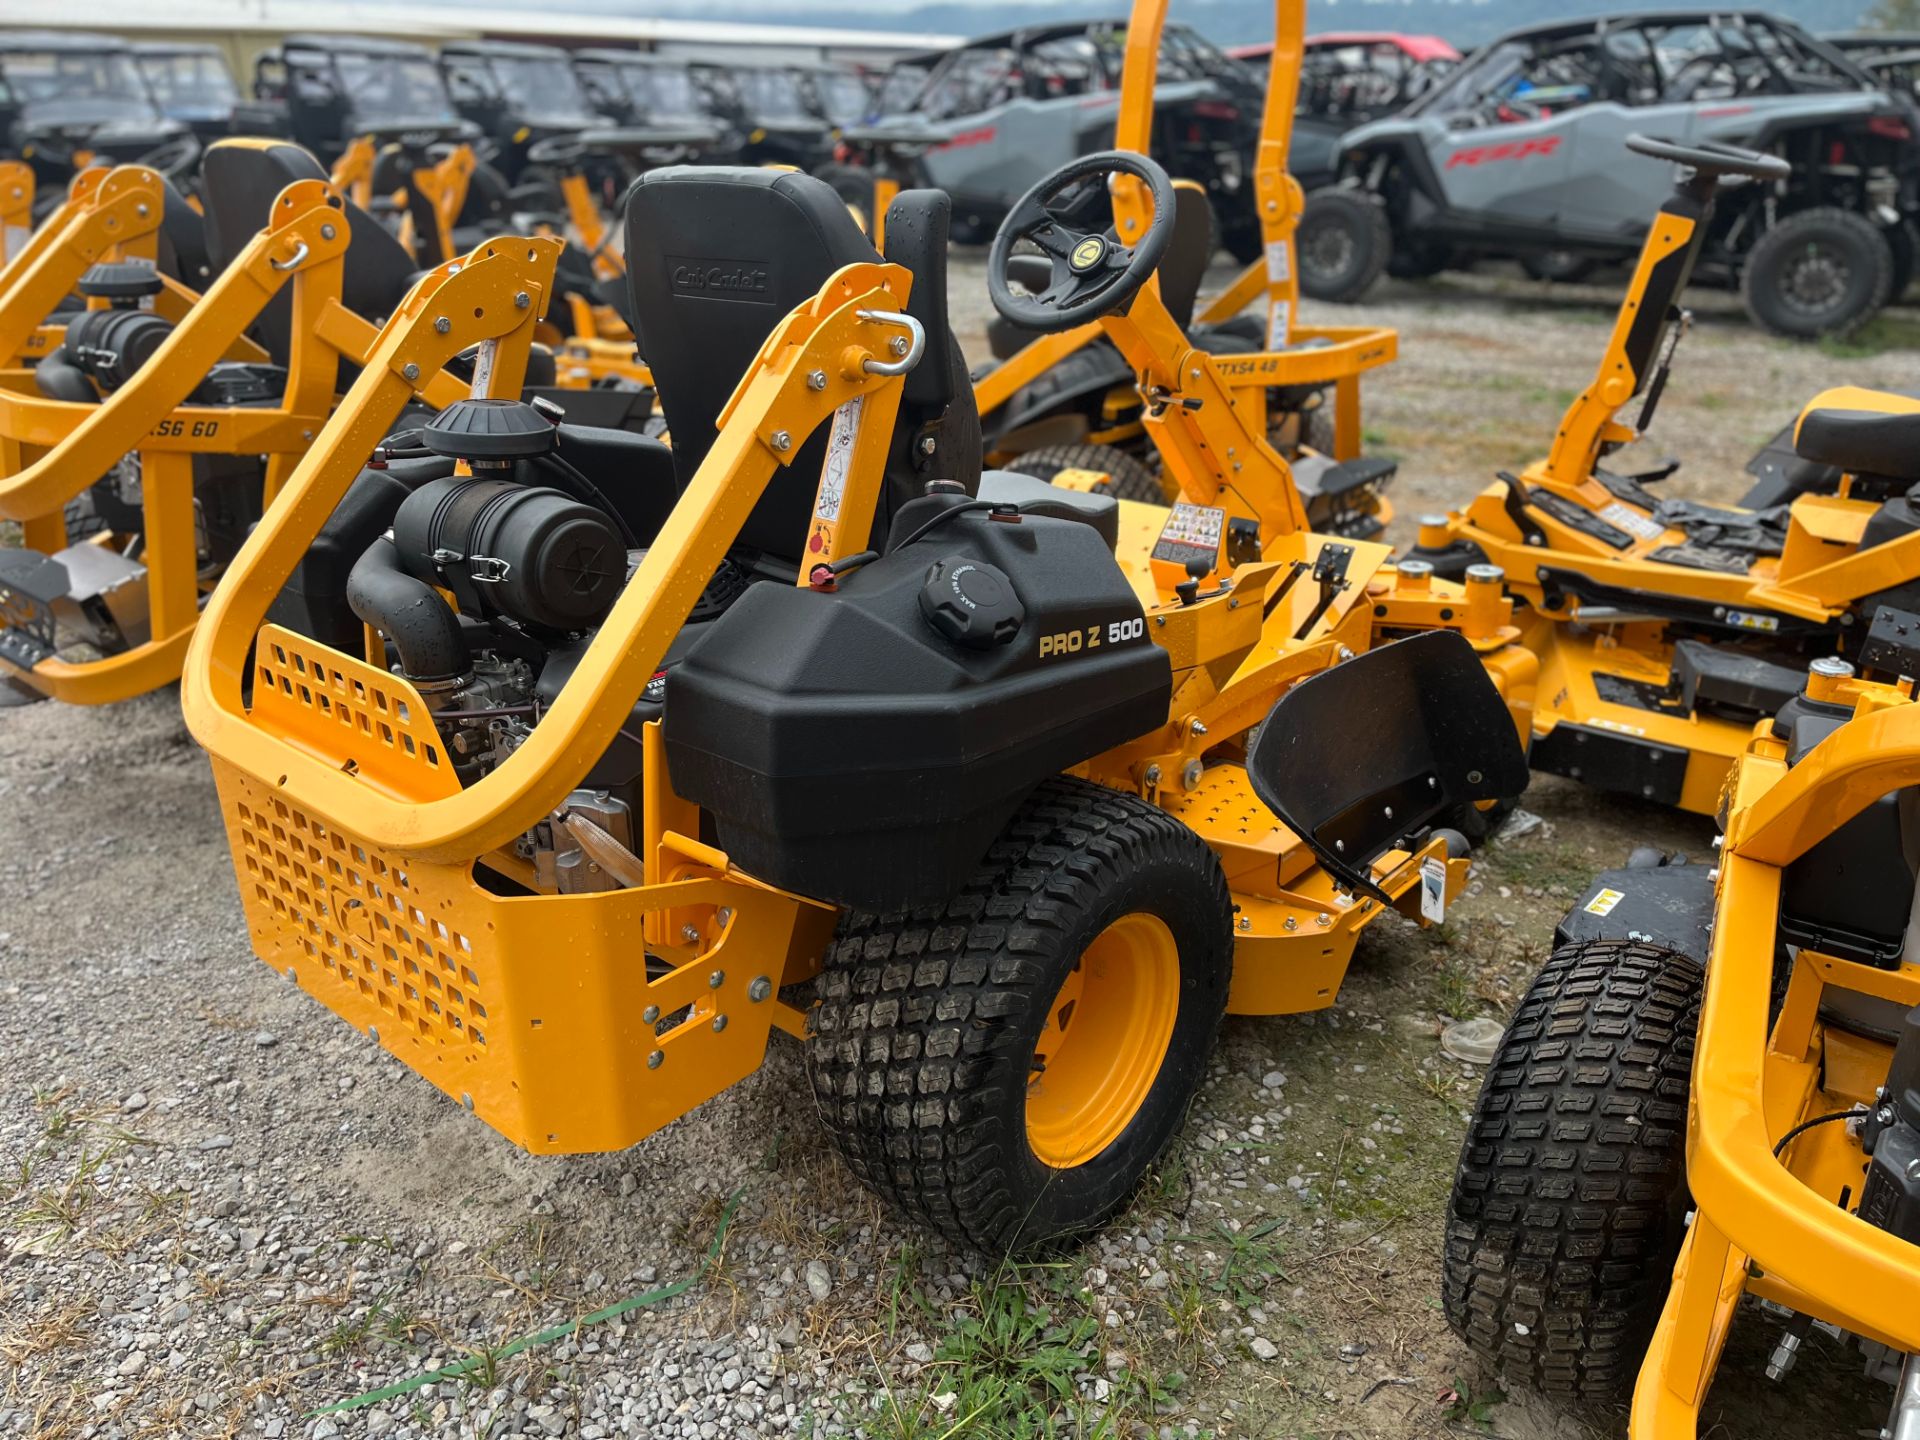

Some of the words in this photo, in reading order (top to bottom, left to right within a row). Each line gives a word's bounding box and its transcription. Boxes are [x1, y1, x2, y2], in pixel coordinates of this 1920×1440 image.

[1259, 360, 1279, 374] 48
[191, 421, 219, 437] 60
[1039, 629, 1083, 658] PRO
[1087, 625, 1101, 649] Z
[1108, 617, 1144, 643] 500
